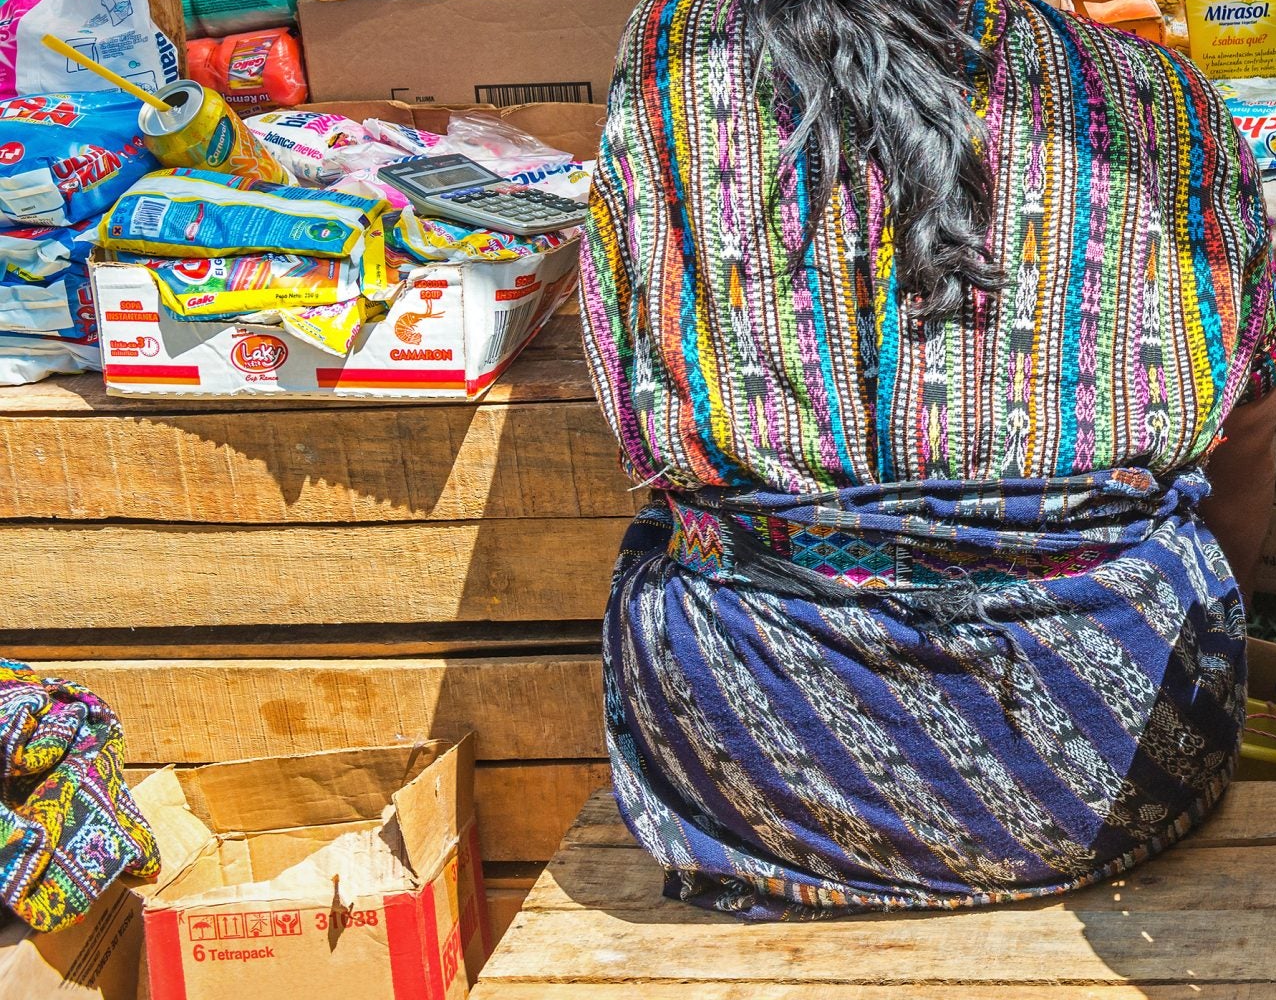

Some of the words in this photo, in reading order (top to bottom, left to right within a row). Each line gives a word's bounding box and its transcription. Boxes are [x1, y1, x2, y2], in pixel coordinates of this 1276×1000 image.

[1218, 51, 1254, 60] alimentación
[232, 56, 266, 70] Gallo
[1205, 62, 1210, 70] y
[1211, 60, 1243, 68] balanceada
[1243, 57, 1274, 68] contribuye
[1210, 67, 1242, 75] crecimiento
[416, 95, 435, 103] PLUMA
[264, 131, 296, 149] blanca
[292, 143, 324, 160] nieves
[187, 294, 216, 308] Gallo
[420, 290, 443, 300] SOUP
[120, 301, 143, 310] SOPA
[136, 336, 145, 348] 3
[390, 348, 453, 361] CAMARON
[245, 374, 258, 382] Cup
[315, 909, 379, 931] 31038
[191, 944, 207, 962] 6
[209, 948, 275, 961] Tetrapack
